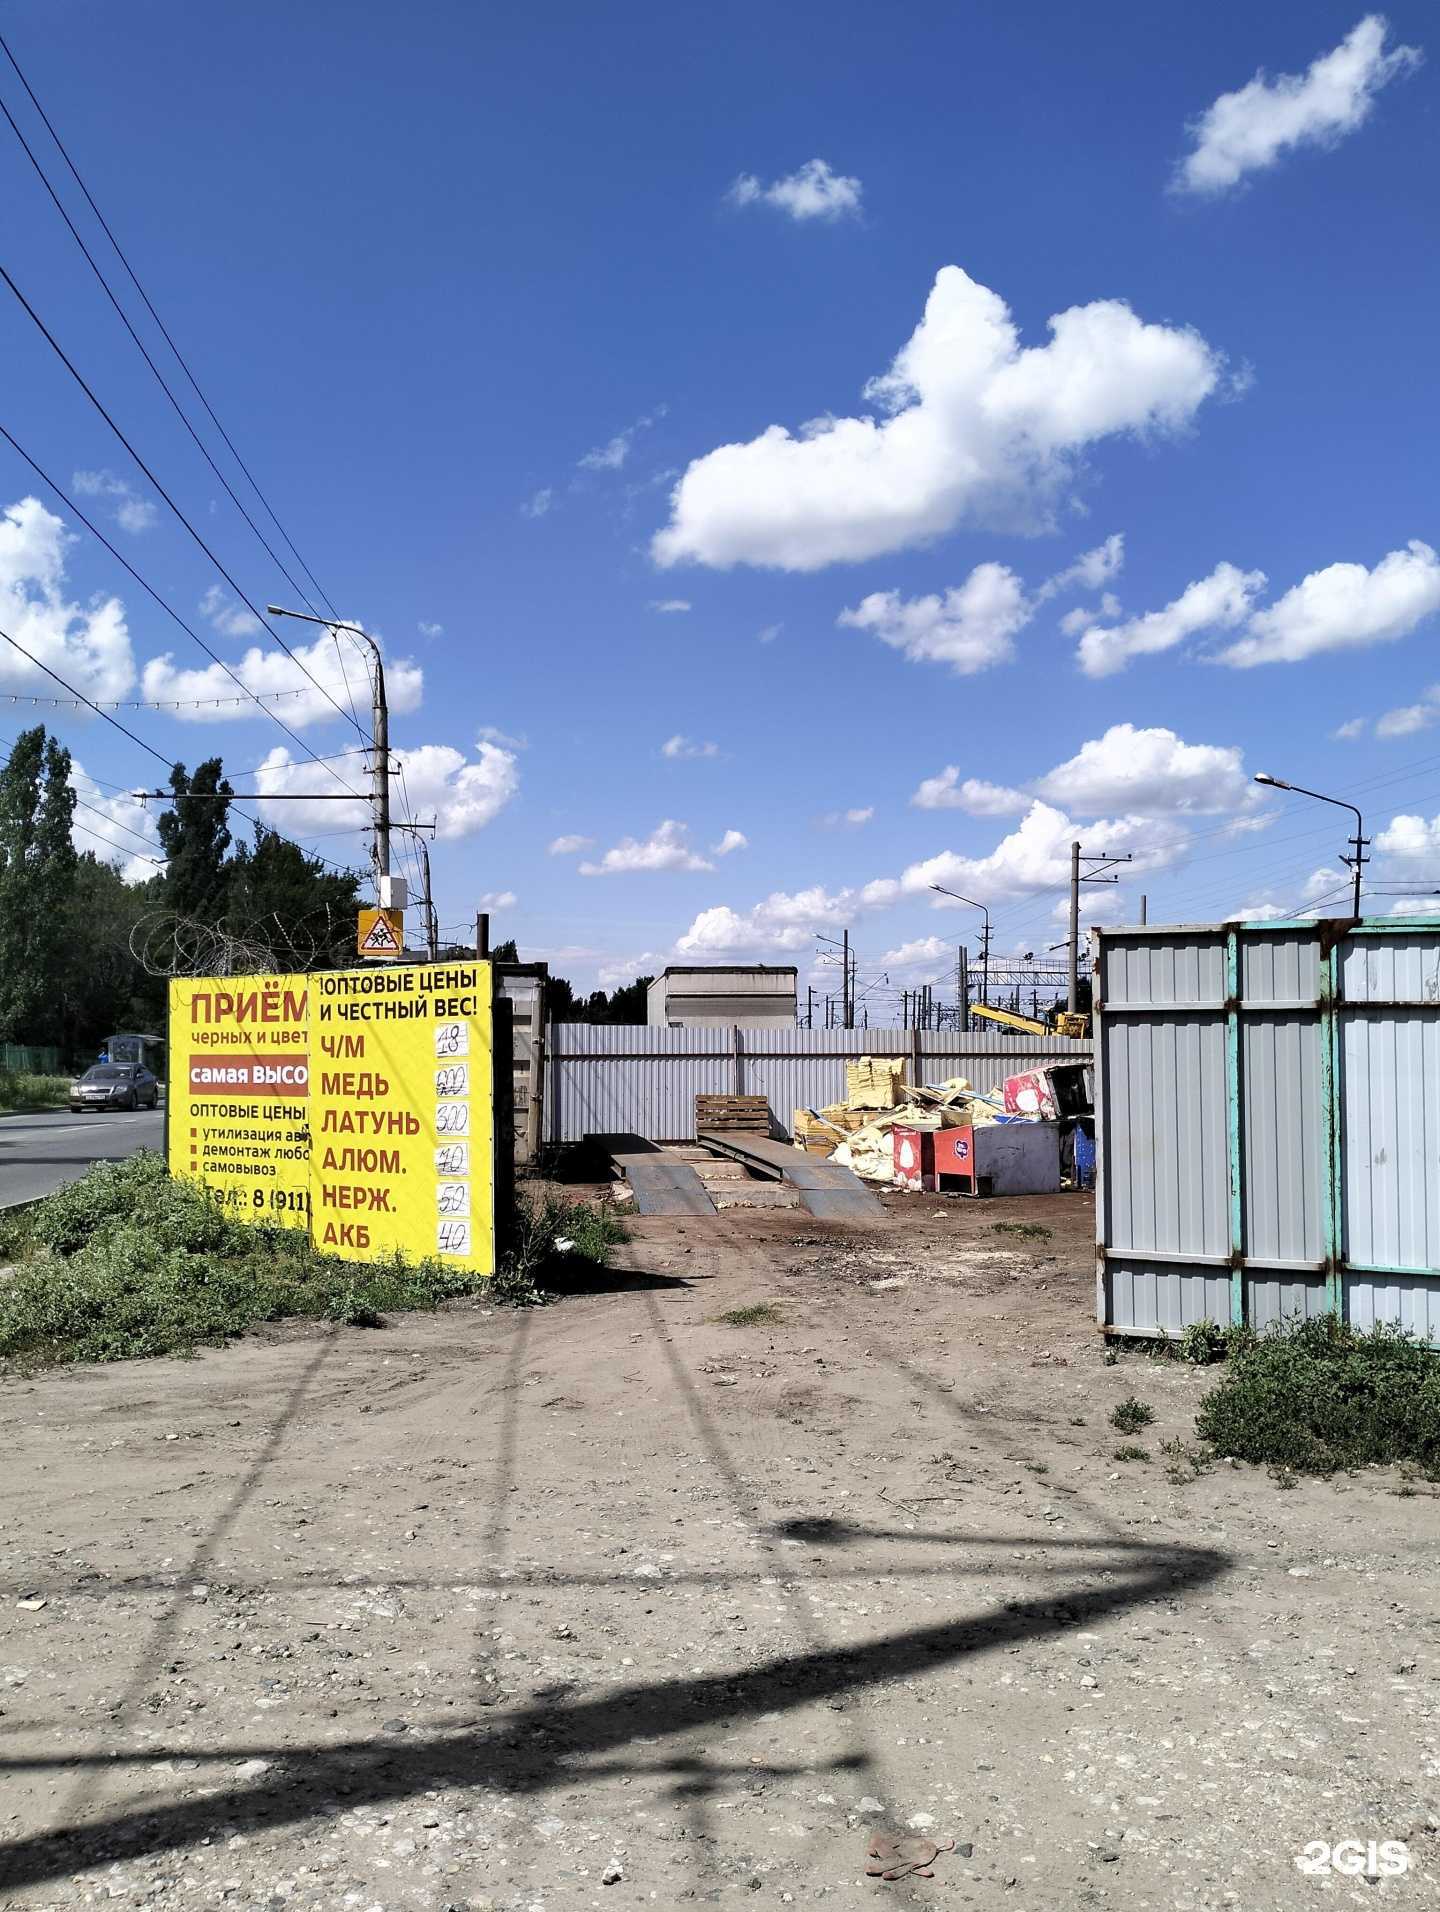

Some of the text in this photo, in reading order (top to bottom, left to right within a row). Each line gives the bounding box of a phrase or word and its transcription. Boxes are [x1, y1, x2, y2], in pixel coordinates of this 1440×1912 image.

[420, 969, 477, 993] ЦЕНЫ
[191, 980, 308, 1023] ПРИЁМ
[321, 995, 477, 1021] И ЧЕСТНЫЙ ВЕС!
[192, 1031, 308, 1047] черных и цвет
[321, 1035, 365, 1058] Ч/М
[191, 1066, 308, 1084] самая ВЫСО
[322, 1073, 389, 1100] МЕДЬ
[190, 1103, 306, 1122] ОПТОВЫЕ ЦЕНЫ
[321, 1110, 420, 1136] ЛАТУНЬ
[203, 1128, 309, 1142] утилизация ав
[203, 1145, 309, 1160] демонтаж любо
[322, 1148, 407, 1174] АЛЮМ.
[203, 1161, 276, 1175] самовывоз
[253, 1189, 264, 1208] 8
[322, 1185, 397, 1213] НЕРЖ.
[323, 1222, 370, 1249] АКБ
[439, 1223, 466, 1249] 40
